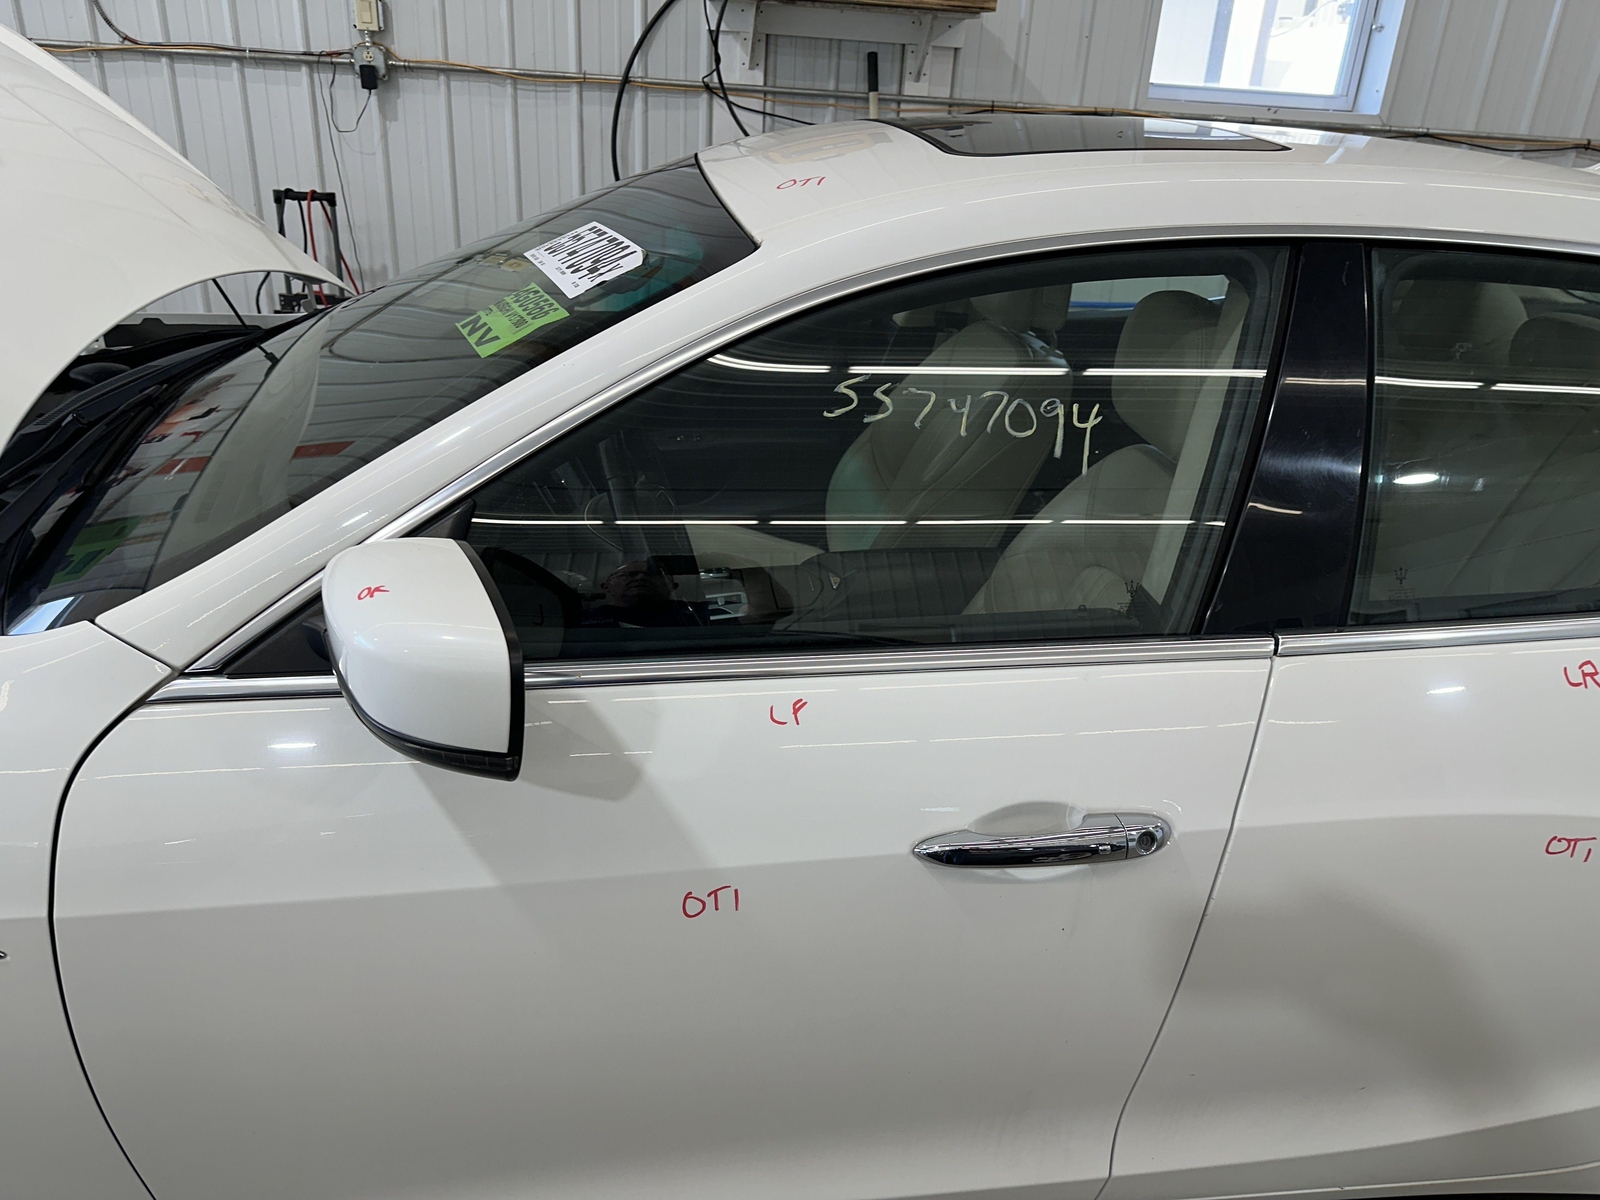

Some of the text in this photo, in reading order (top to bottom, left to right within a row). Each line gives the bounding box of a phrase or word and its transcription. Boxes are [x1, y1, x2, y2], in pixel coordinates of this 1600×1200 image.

[460, 314, 501, 348] NV
[822, 373, 1104, 477] 55747094
[1563, 659, 1600, 690] LR
